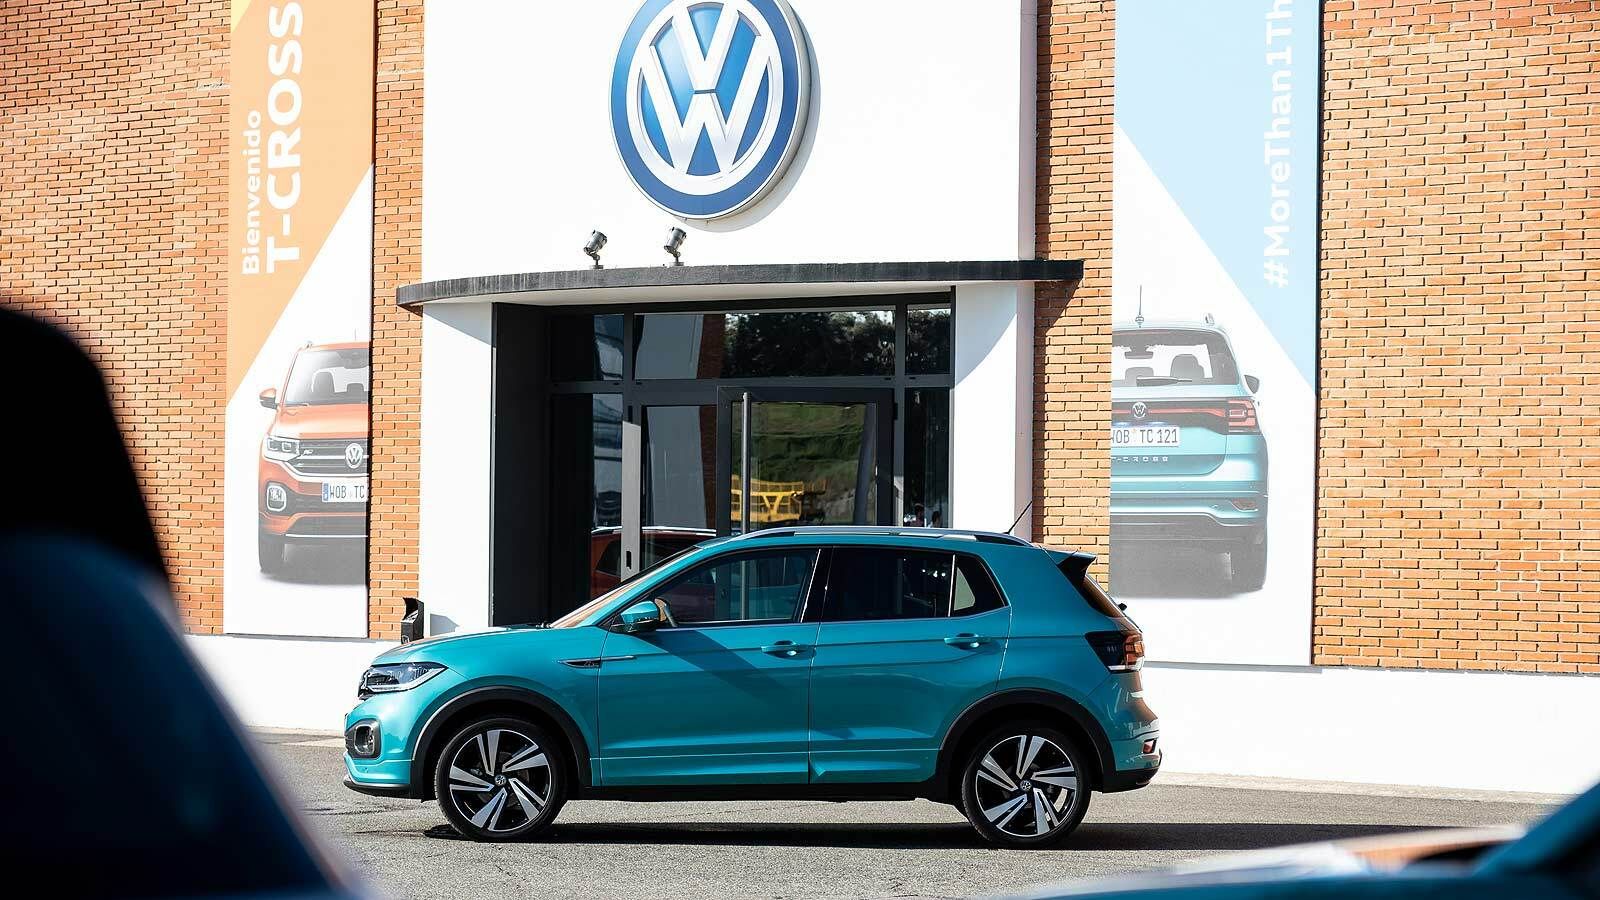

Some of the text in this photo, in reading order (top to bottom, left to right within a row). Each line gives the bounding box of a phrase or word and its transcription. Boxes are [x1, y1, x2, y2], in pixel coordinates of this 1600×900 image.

[266, 2, 304, 274] T-CROSS
[241, 110, 262, 274] Bienvenido
[1140, 428, 1154, 444] TC
[1156, 428, 1178, 444] 121
[353, 484, 365, 500] TC
